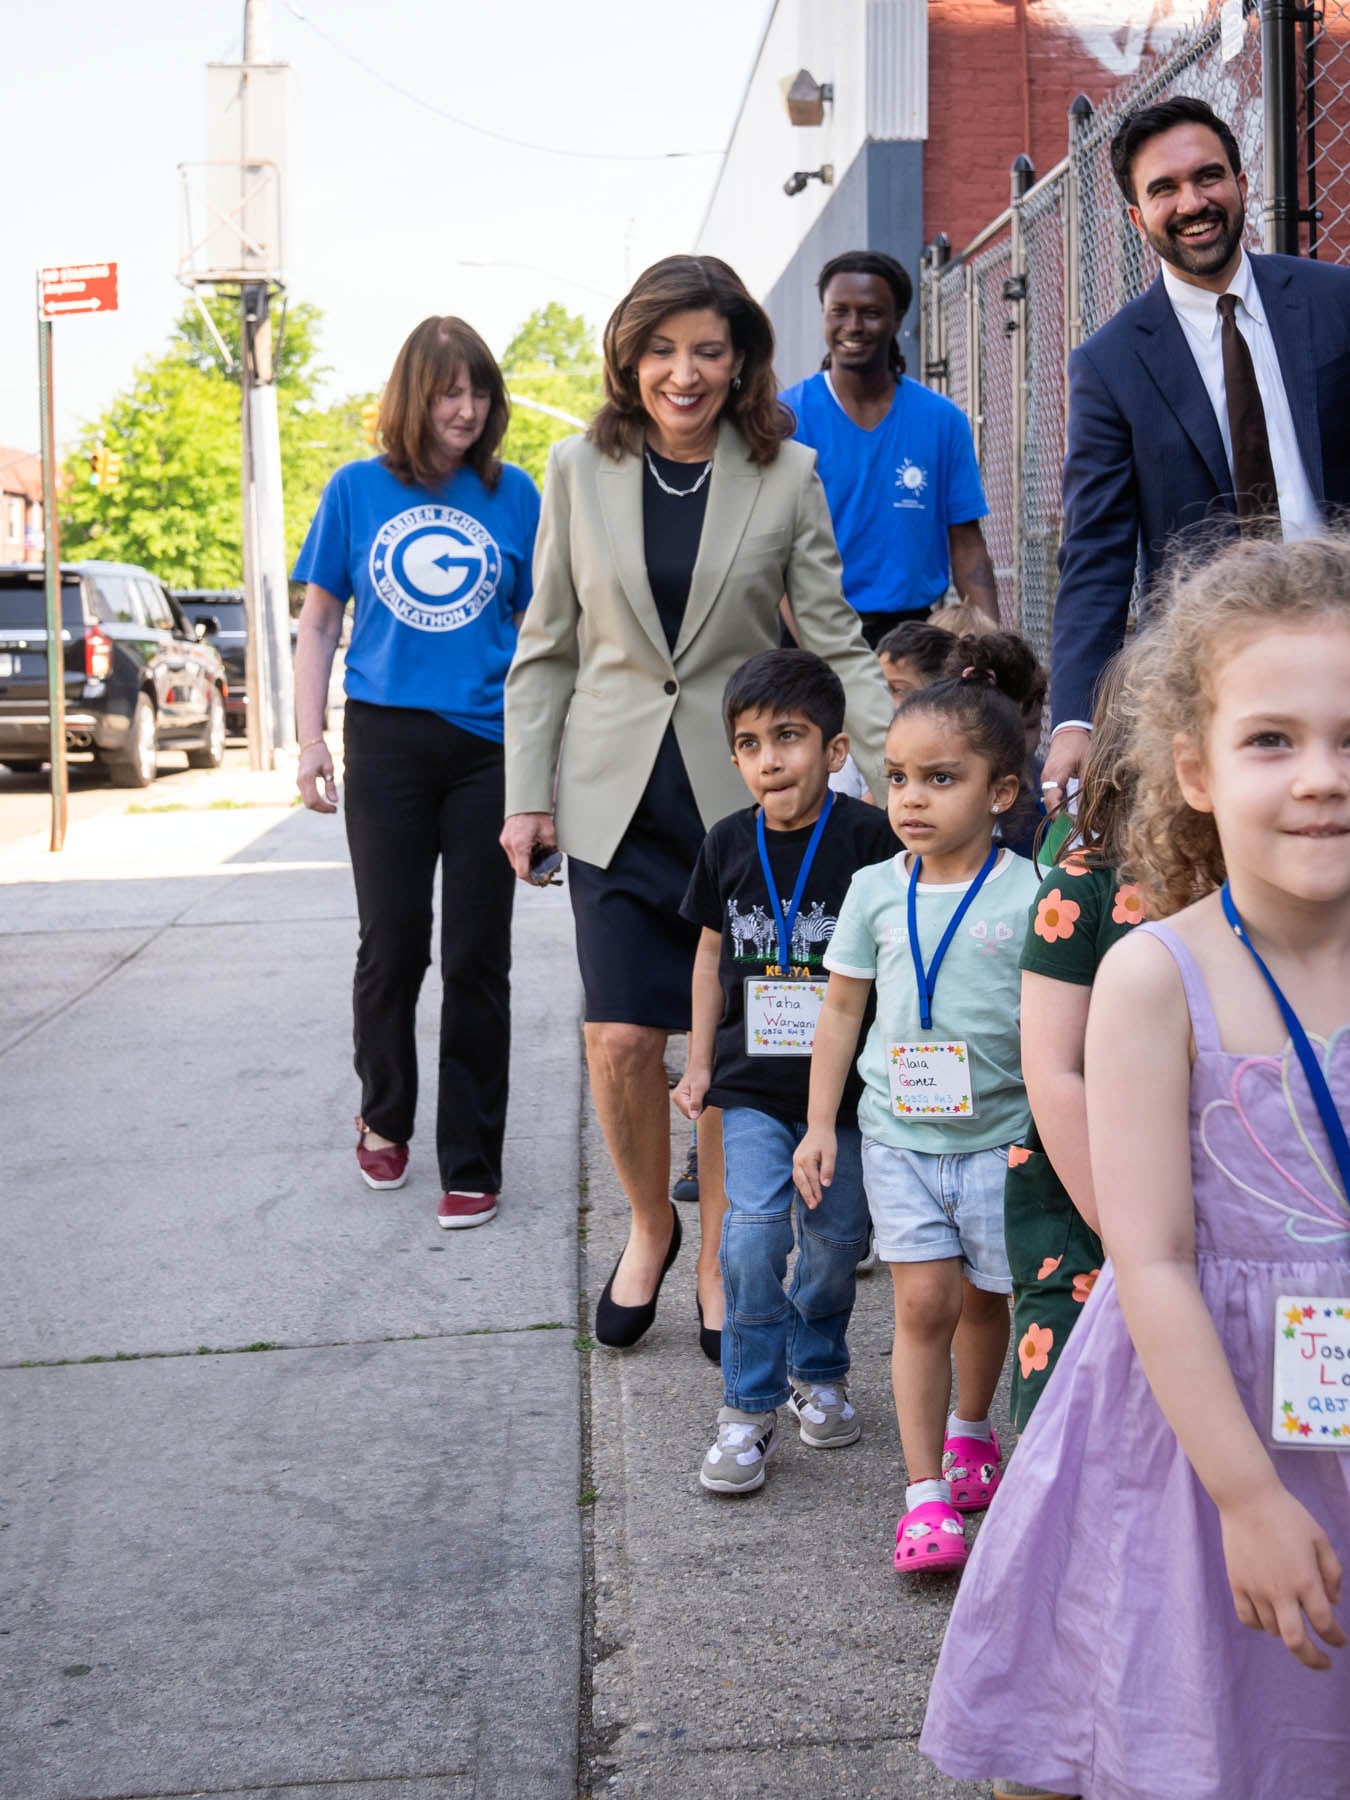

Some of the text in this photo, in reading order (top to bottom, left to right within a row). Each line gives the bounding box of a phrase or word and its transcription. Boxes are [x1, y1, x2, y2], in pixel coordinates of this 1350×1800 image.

[380, 507, 491, 549] GARDEN SCHOOL
[378, 577, 467, 627] WALKATHON
[765, 964, 811, 977] KEYA
[761, 995, 800, 1009] Taha
[899, 1073, 937, 1087] Gomez
